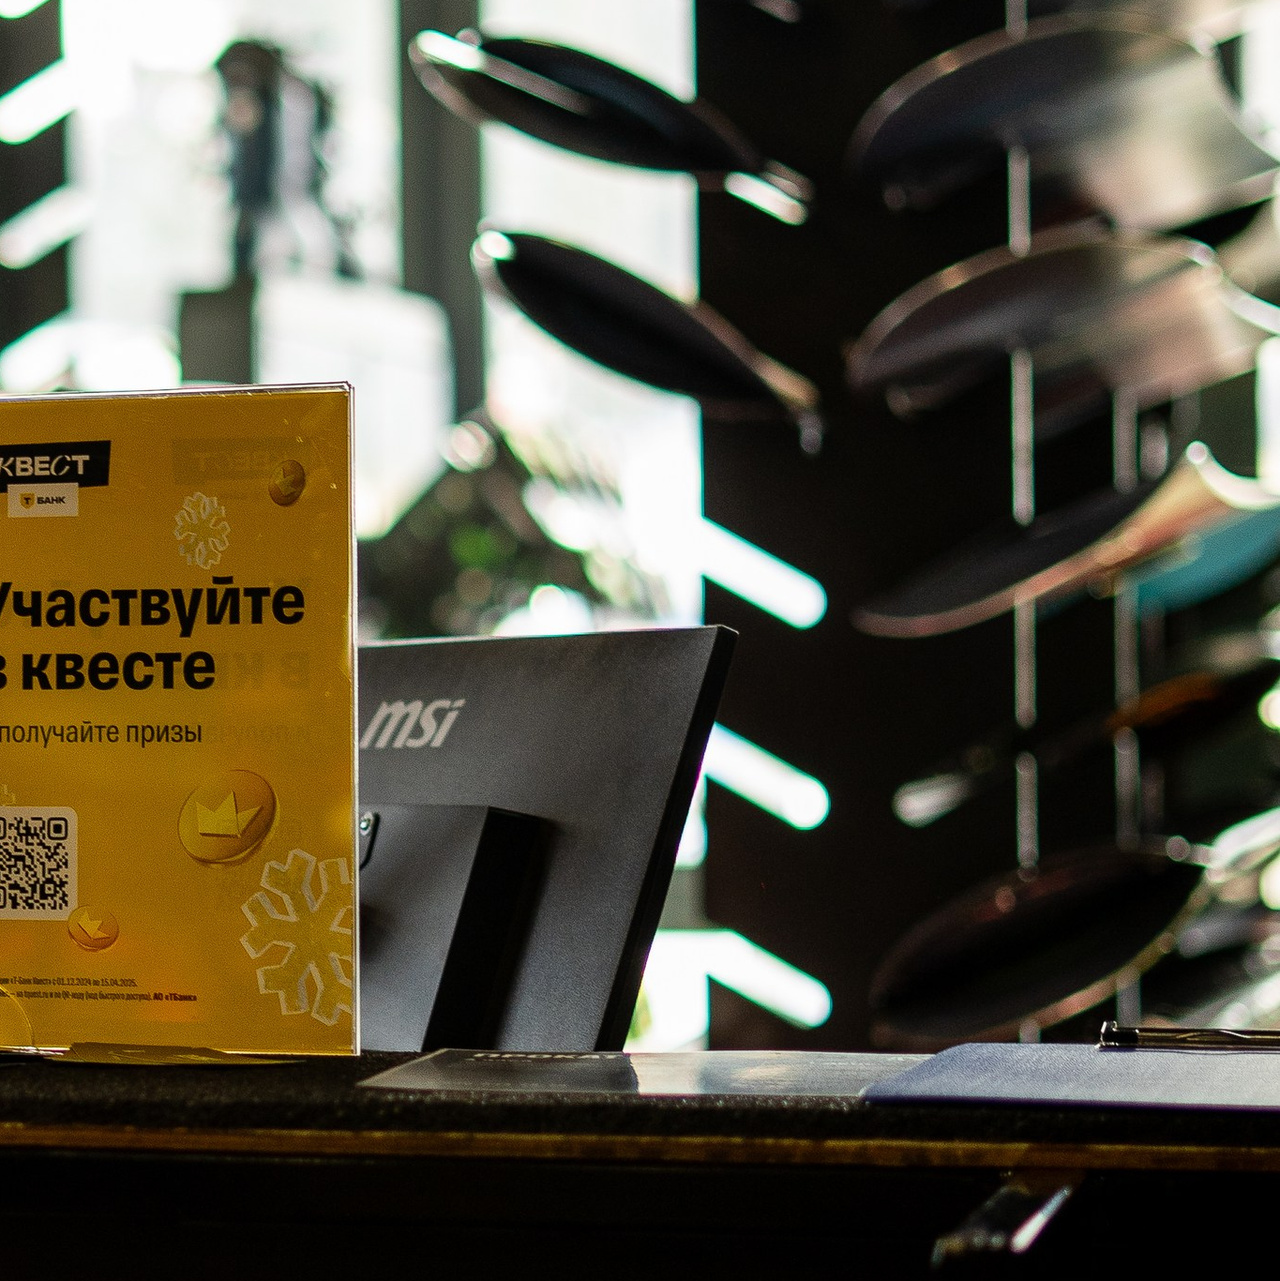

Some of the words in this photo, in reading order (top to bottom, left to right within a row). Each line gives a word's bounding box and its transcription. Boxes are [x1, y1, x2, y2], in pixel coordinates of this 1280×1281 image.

[36, 496, 66, 505] БАНК
[21, 650, 216, 691] квесте
[125, 724, 203, 748] призы
